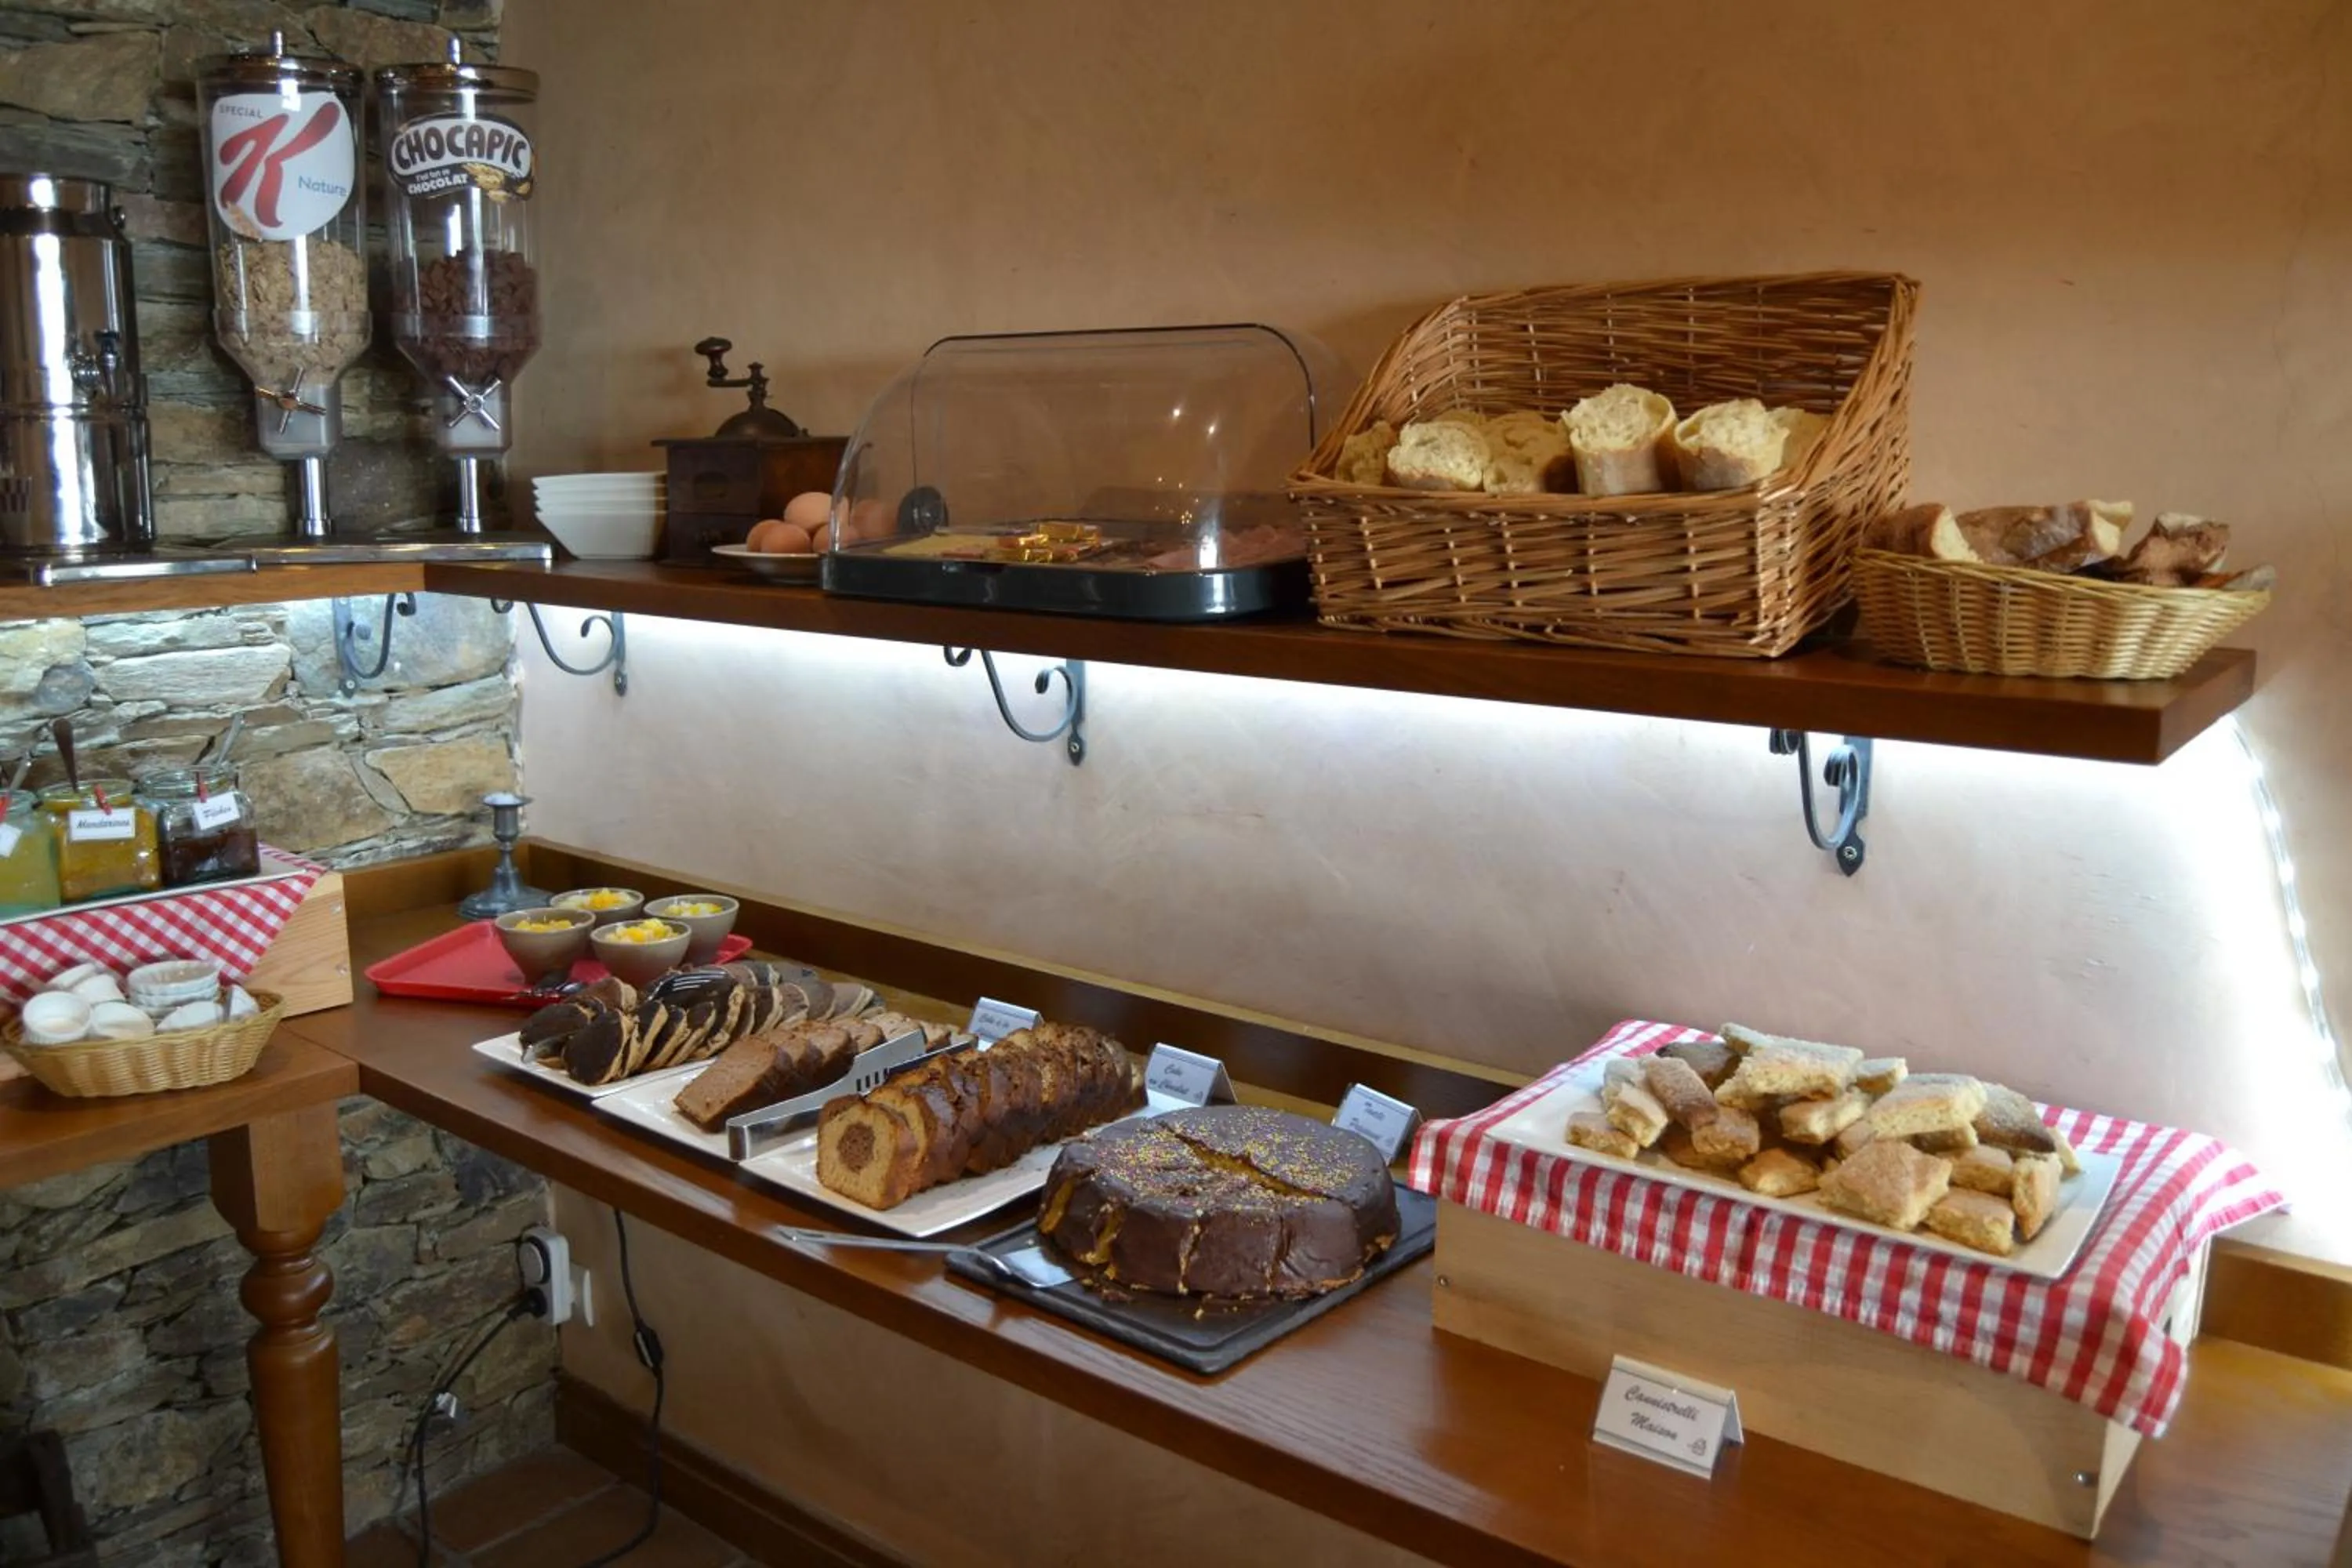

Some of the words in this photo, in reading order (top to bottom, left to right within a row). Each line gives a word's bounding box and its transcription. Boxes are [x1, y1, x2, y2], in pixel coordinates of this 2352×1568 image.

[219, 104, 263, 118] SPECIAL
[394, 124, 527, 170] CHOCAPIC
[220, 101, 340, 228] K
[298, 175, 347, 197] Nature
[408, 173, 468, 194] CHOCOLAT
